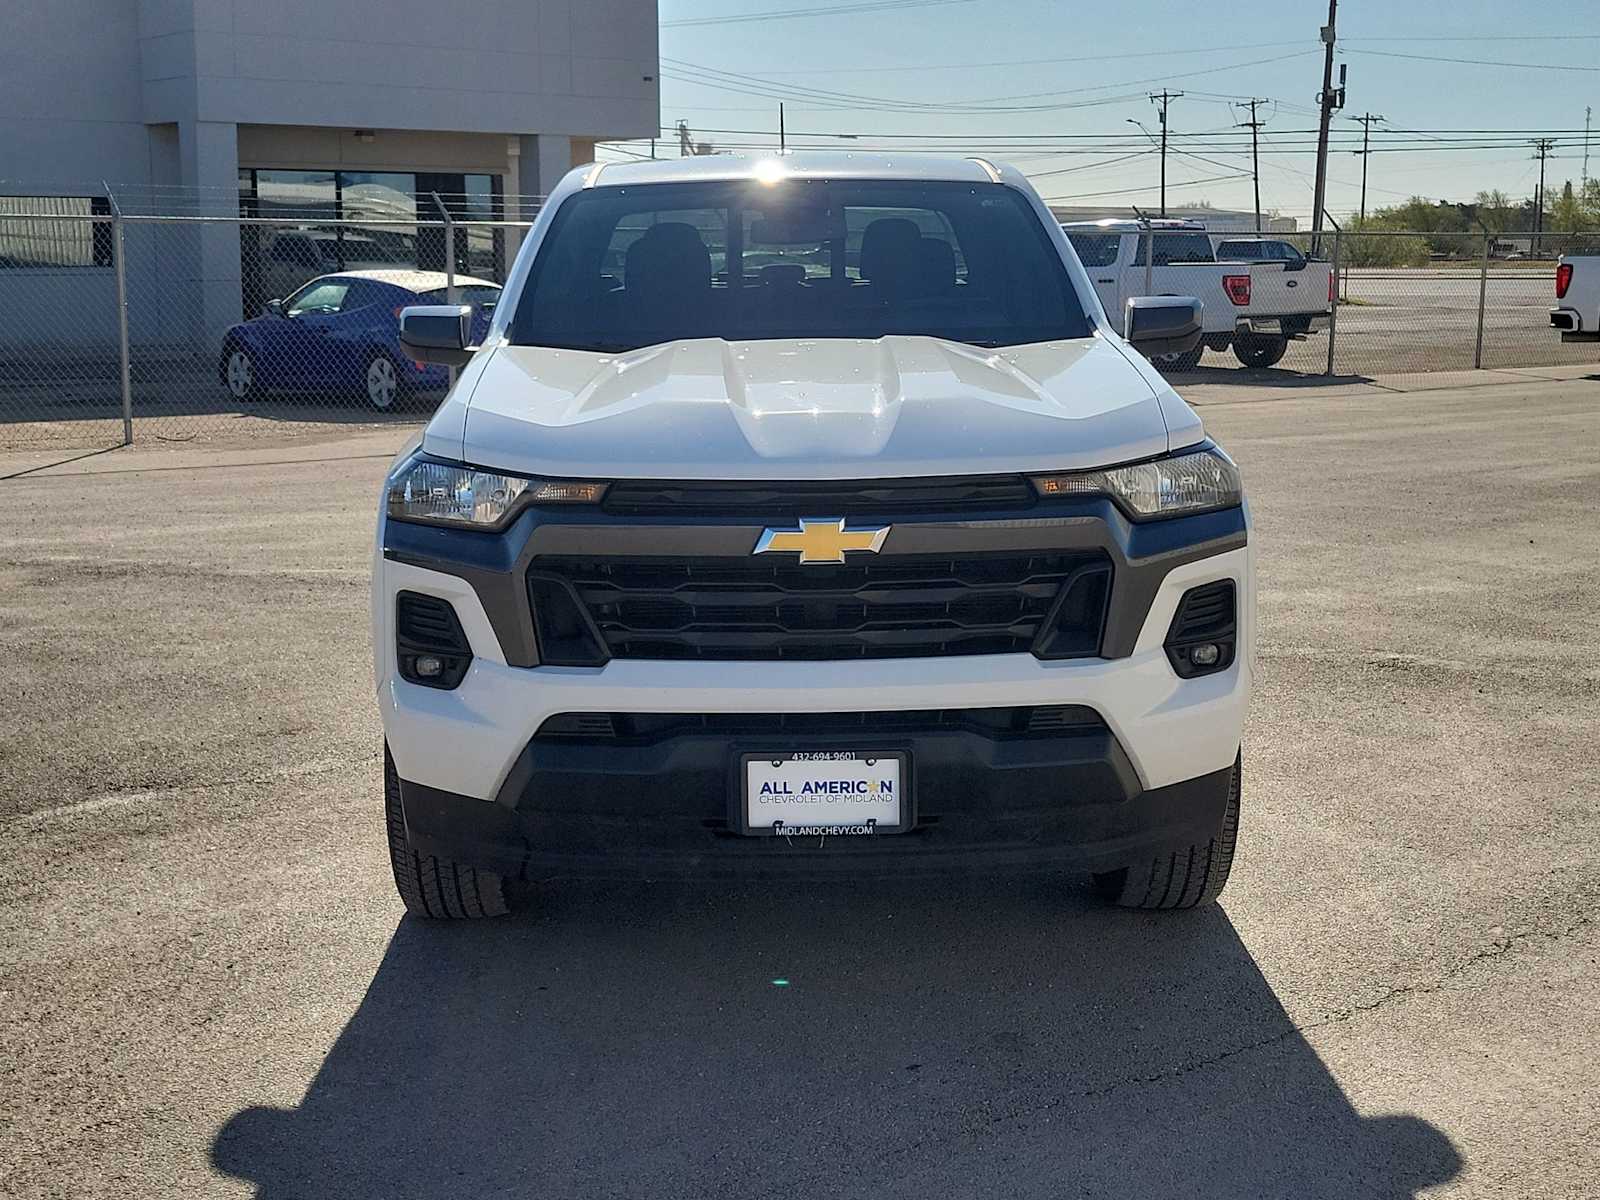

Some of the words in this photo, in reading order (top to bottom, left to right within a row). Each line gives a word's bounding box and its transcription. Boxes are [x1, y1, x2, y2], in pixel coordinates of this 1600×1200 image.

[791, 752, 856, 761] 432-694-9601
[760, 781, 793, 794] ALL
[759, 794, 825, 804] CHEVROLET
[825, 794, 843, 804] OF
[843, 793, 893, 804] MIDLAND
[775, 825, 873, 836] MIDLANDCHEVY.COM
